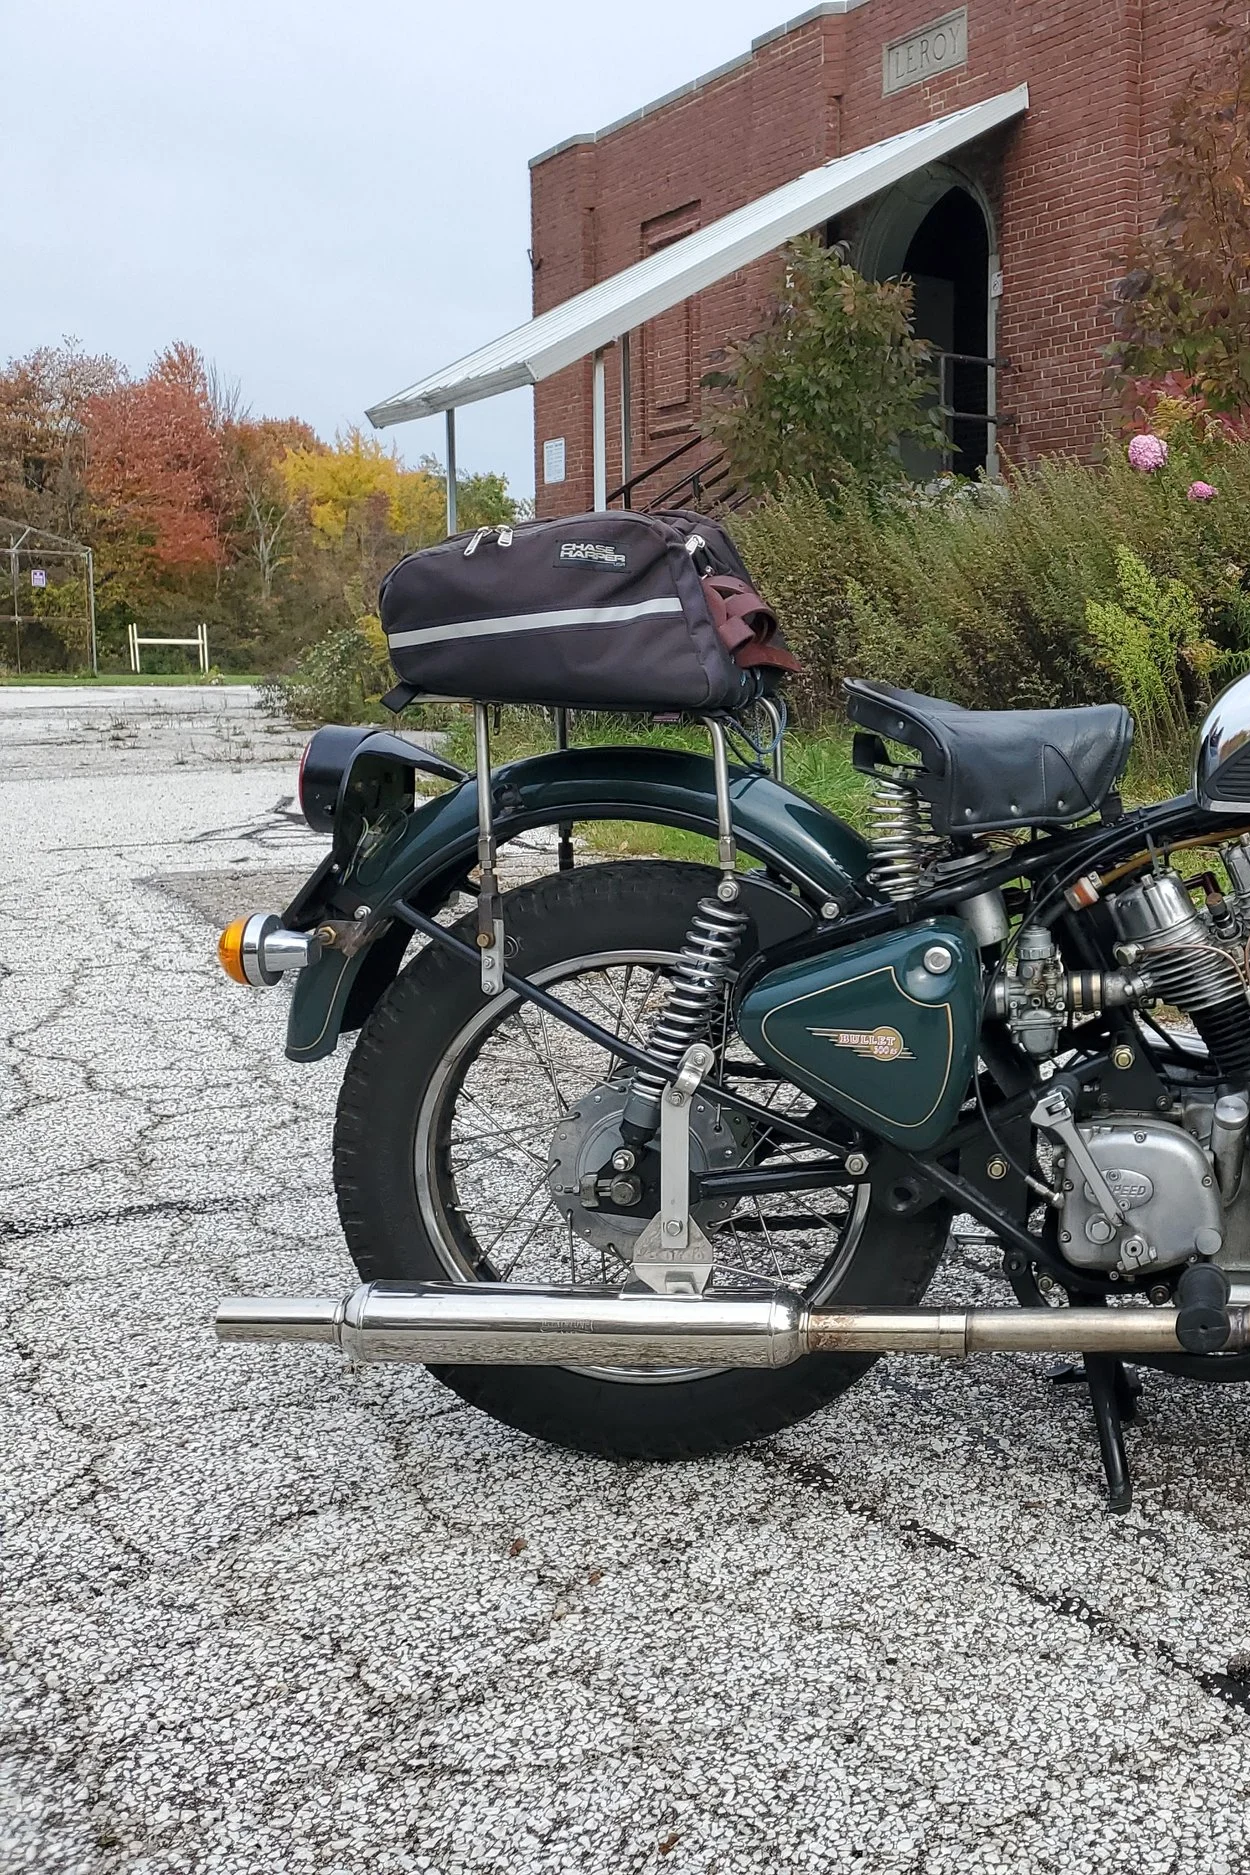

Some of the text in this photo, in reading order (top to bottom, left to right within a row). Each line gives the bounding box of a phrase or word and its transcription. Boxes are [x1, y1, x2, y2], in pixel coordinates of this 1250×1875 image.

[894, 24, 961, 79] LEROY
[560, 543, 615, 555] CHASE
[560, 551, 626, 563] HARPER
[839, 1033, 896, 1046] BULLET
[1110, 1184, 1147, 1197] PEED
